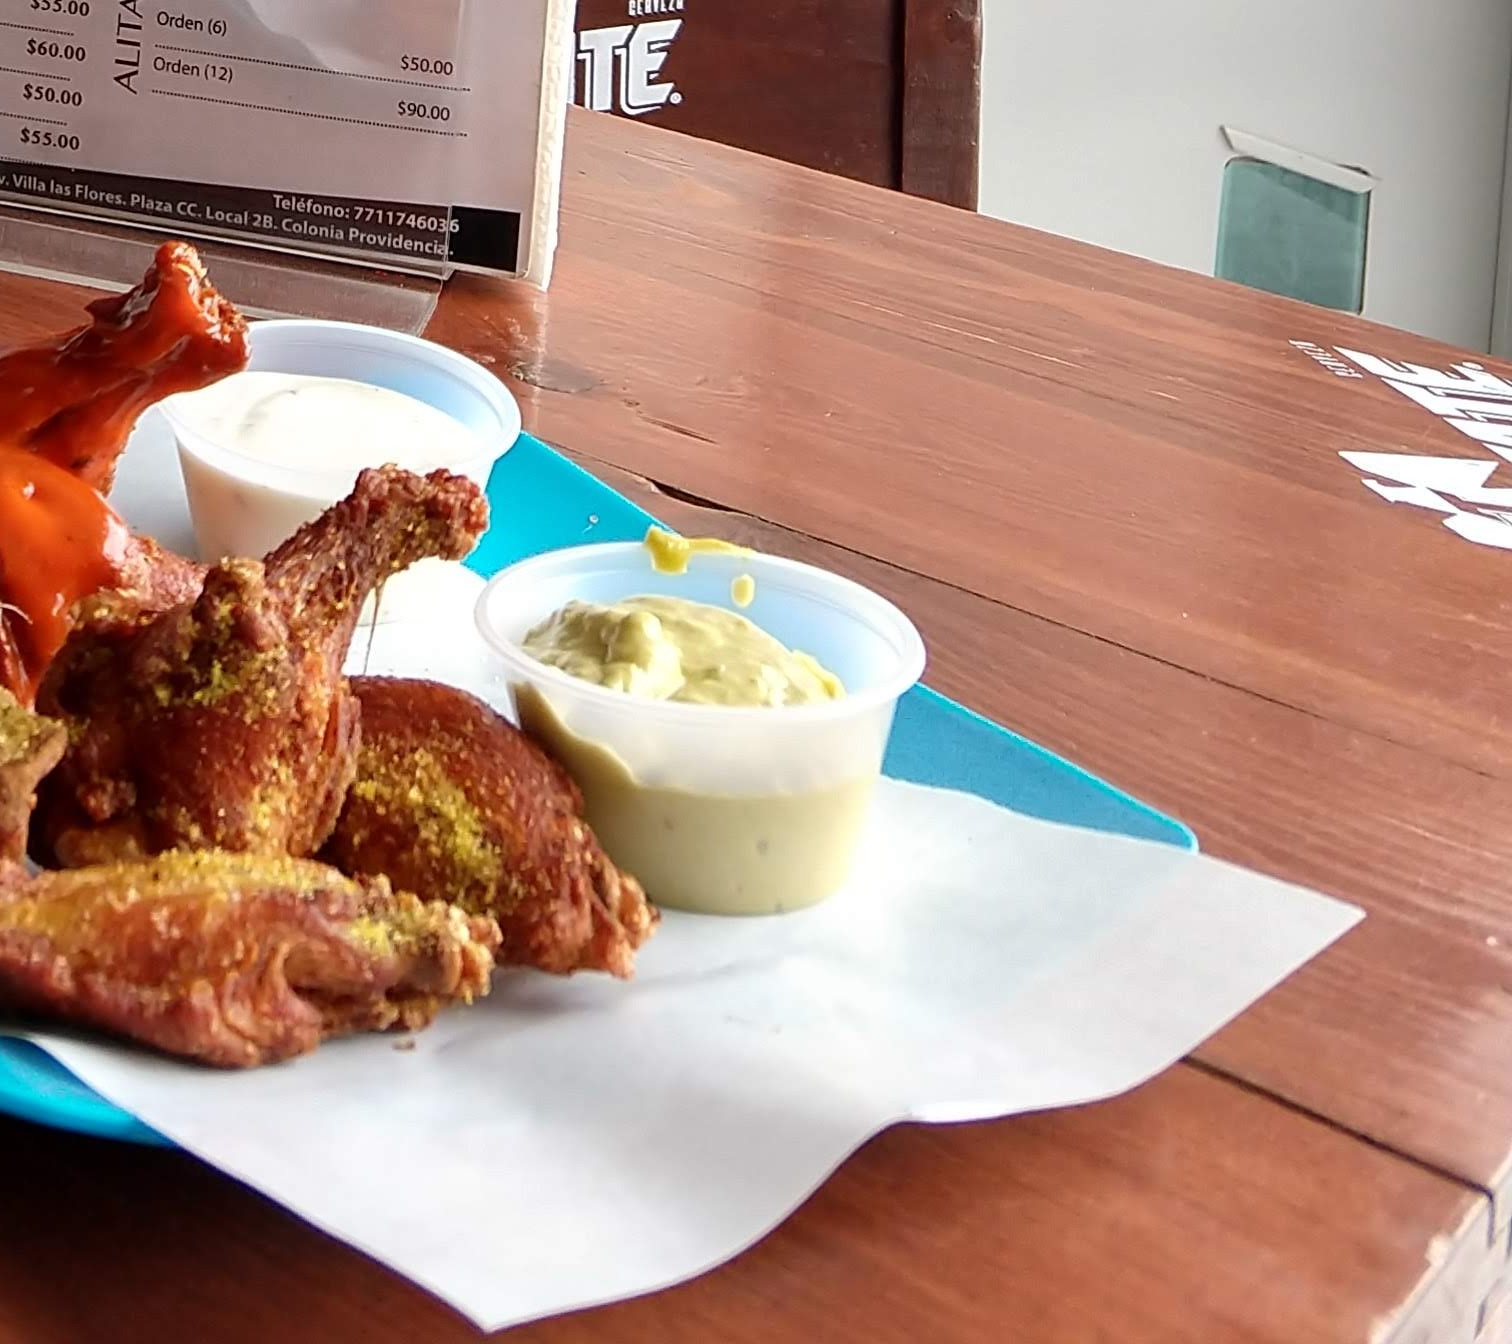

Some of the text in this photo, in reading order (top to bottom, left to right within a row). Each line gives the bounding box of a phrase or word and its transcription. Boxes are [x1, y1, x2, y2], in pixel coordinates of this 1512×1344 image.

[155, 10, 228, 39] Orden (6)
[25, 37, 87, 63] $60.00
[152, 56, 235, 85] Orden (12)
[399, 53, 454, 77] $50.00
[22, 82, 84, 108] $50.00
[396, 99, 451, 123] $90.00
[18, 125, 81, 152] $55.00
[12, 173, 47, 193] Villa
[49, 179, 72, 198] las
[74, 183, 127, 207] Flores.
[129, 192, 174, 214] Plaza
[176, 201, 203, 219] CC.
[205, 205, 249, 227] Local
[251, 212, 278, 231] 2B.
[281, 218, 345, 242] Colonia
[272, 193, 461, 234] Teléfono: 7711746036
